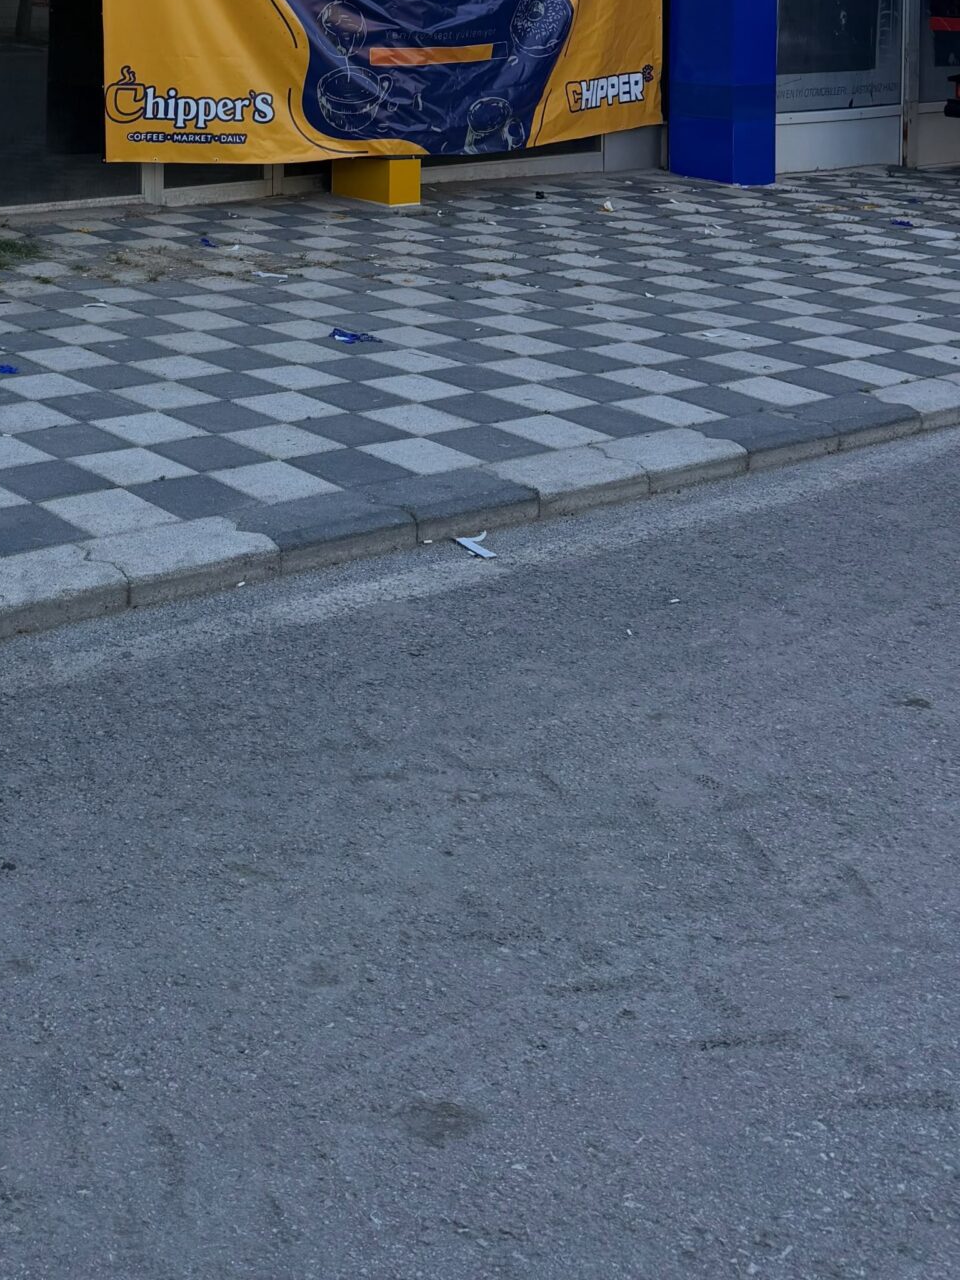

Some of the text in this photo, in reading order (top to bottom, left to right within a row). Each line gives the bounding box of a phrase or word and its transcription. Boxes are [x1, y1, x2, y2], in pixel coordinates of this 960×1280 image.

[127, 131, 247, 144] COFFEE MARKET DAILY
